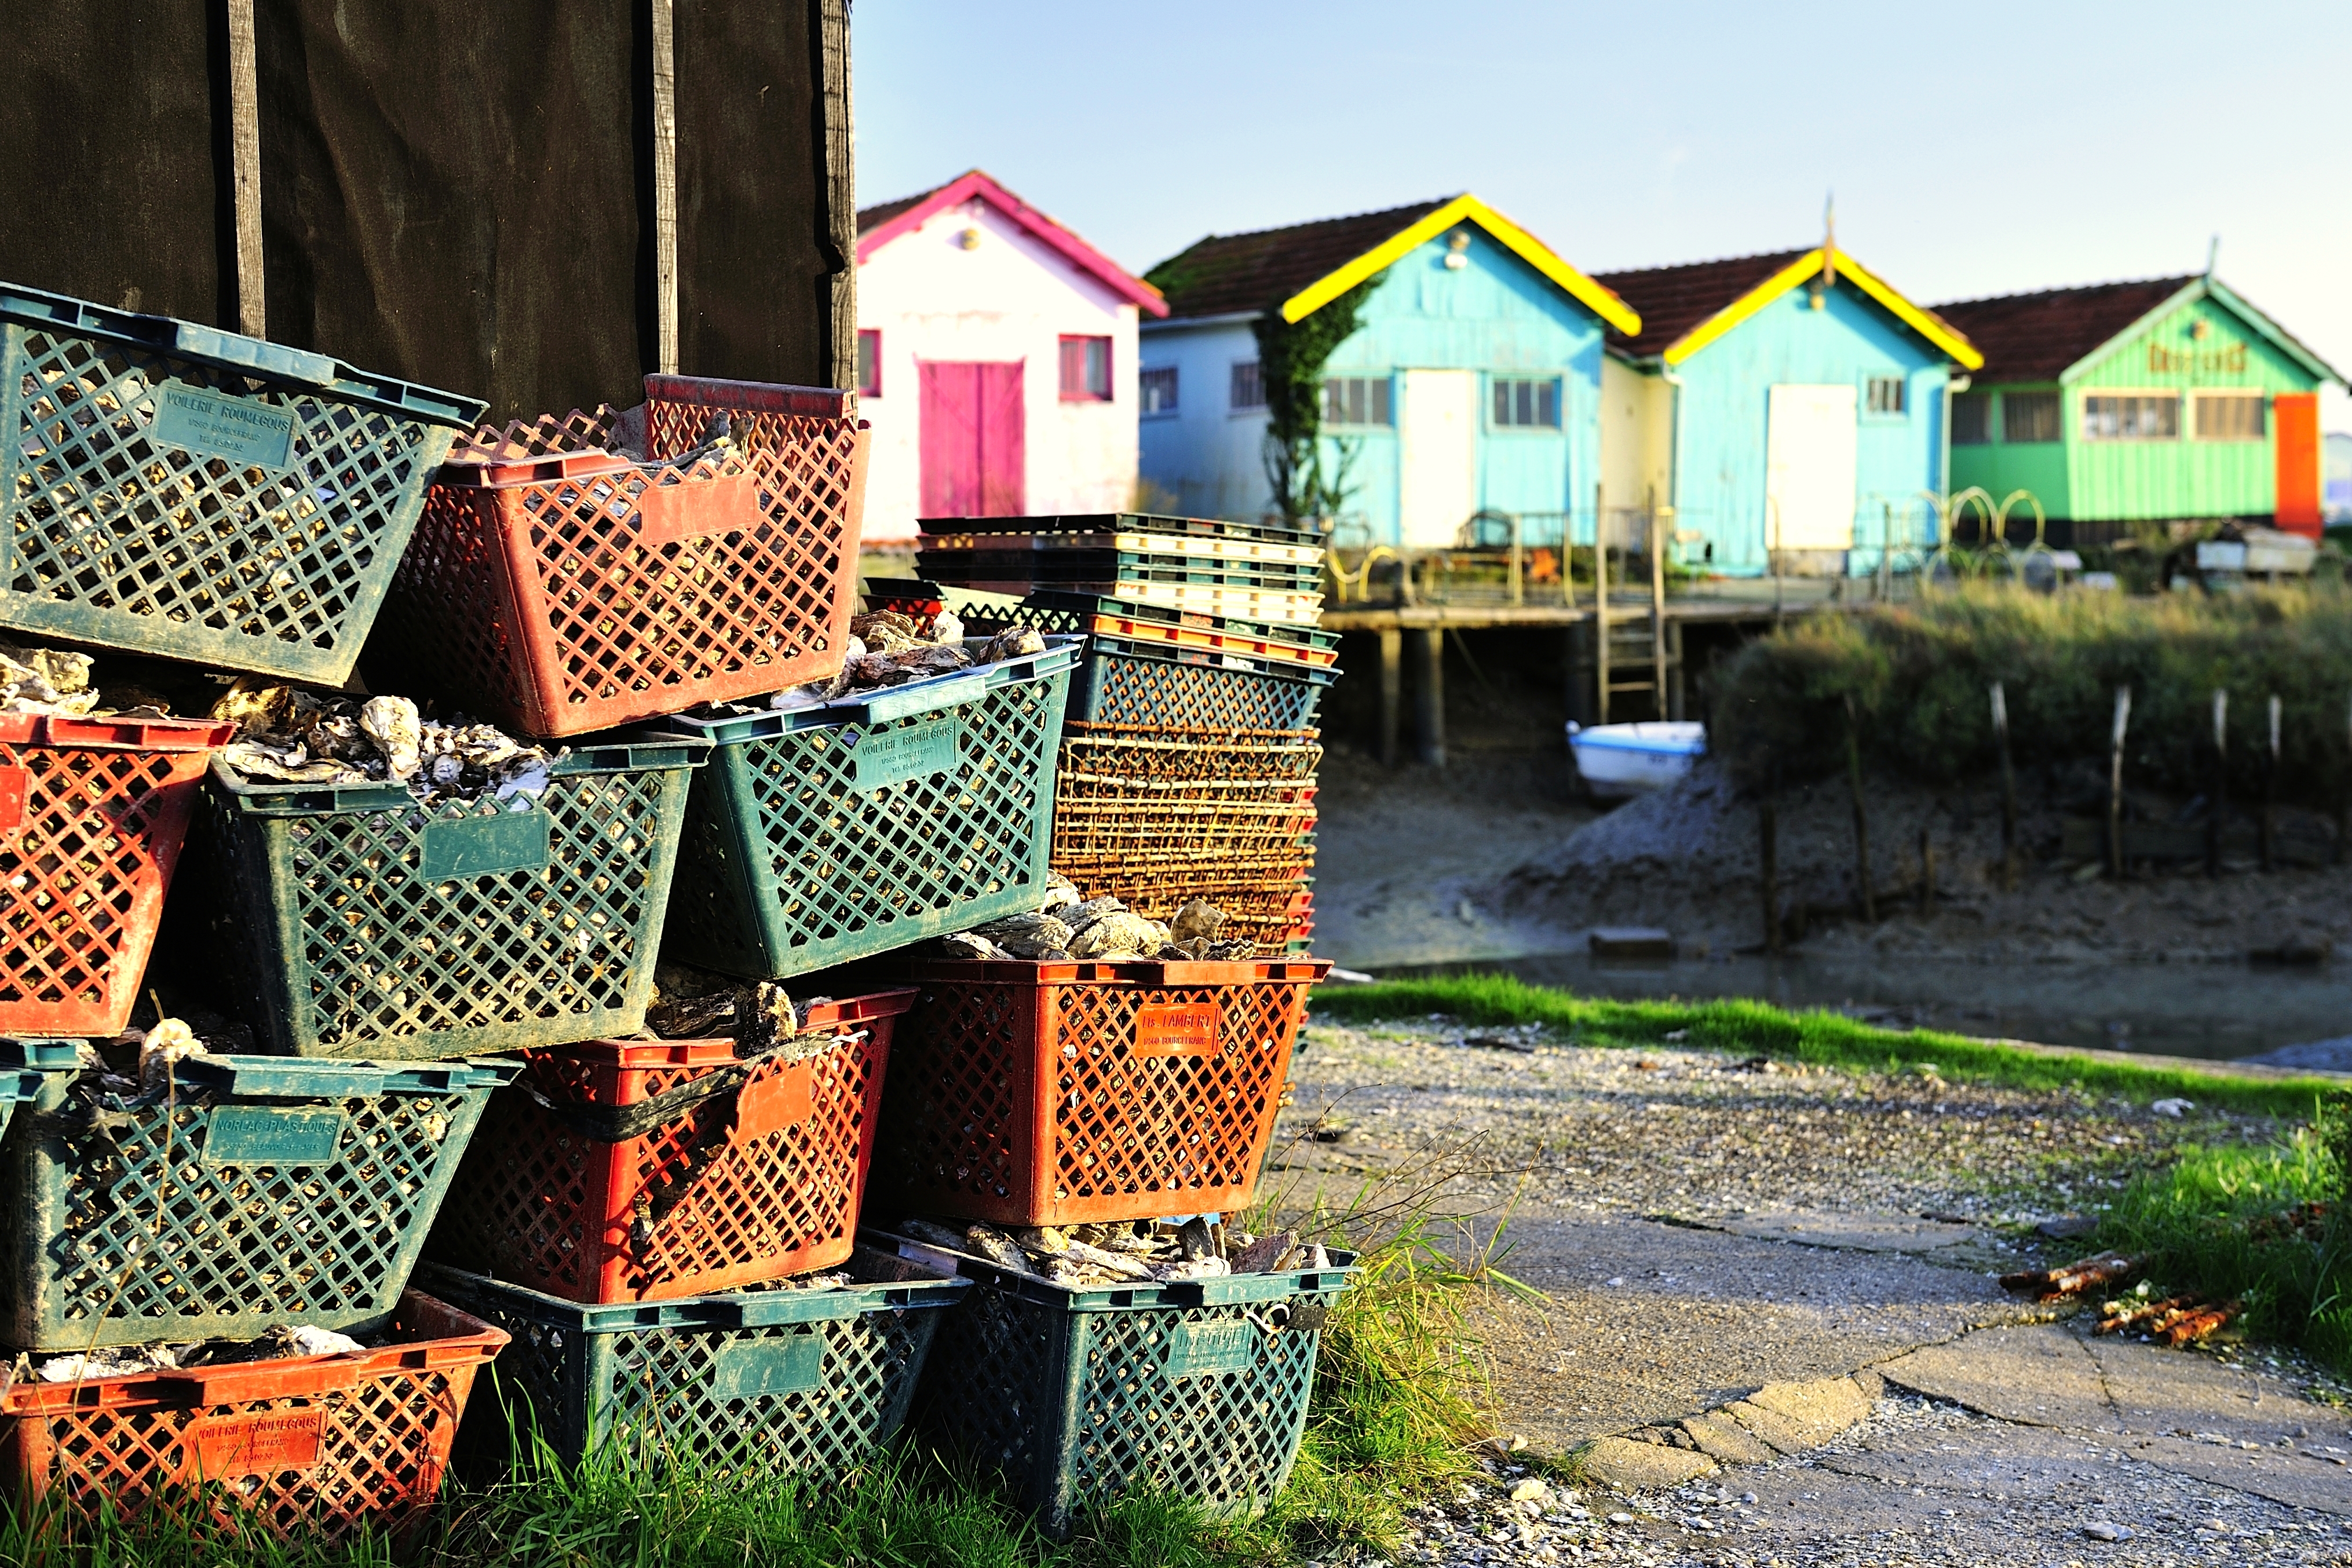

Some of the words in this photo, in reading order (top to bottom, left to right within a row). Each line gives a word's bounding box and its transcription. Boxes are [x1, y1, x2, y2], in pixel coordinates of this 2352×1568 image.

[167, 393, 216, 414] VOILERIE
[221, 406, 290, 432] ROUMEGOUS
[862, 740, 898, 755] VOILERIE
[903, 726, 953, 746] ROUMEGOUS
[1163, 1014, 1210, 1027] LAMBERT
[198, 1424, 239, 1439] VOILERIE
[249, 1417, 317, 1433] ROUMEGOUS
